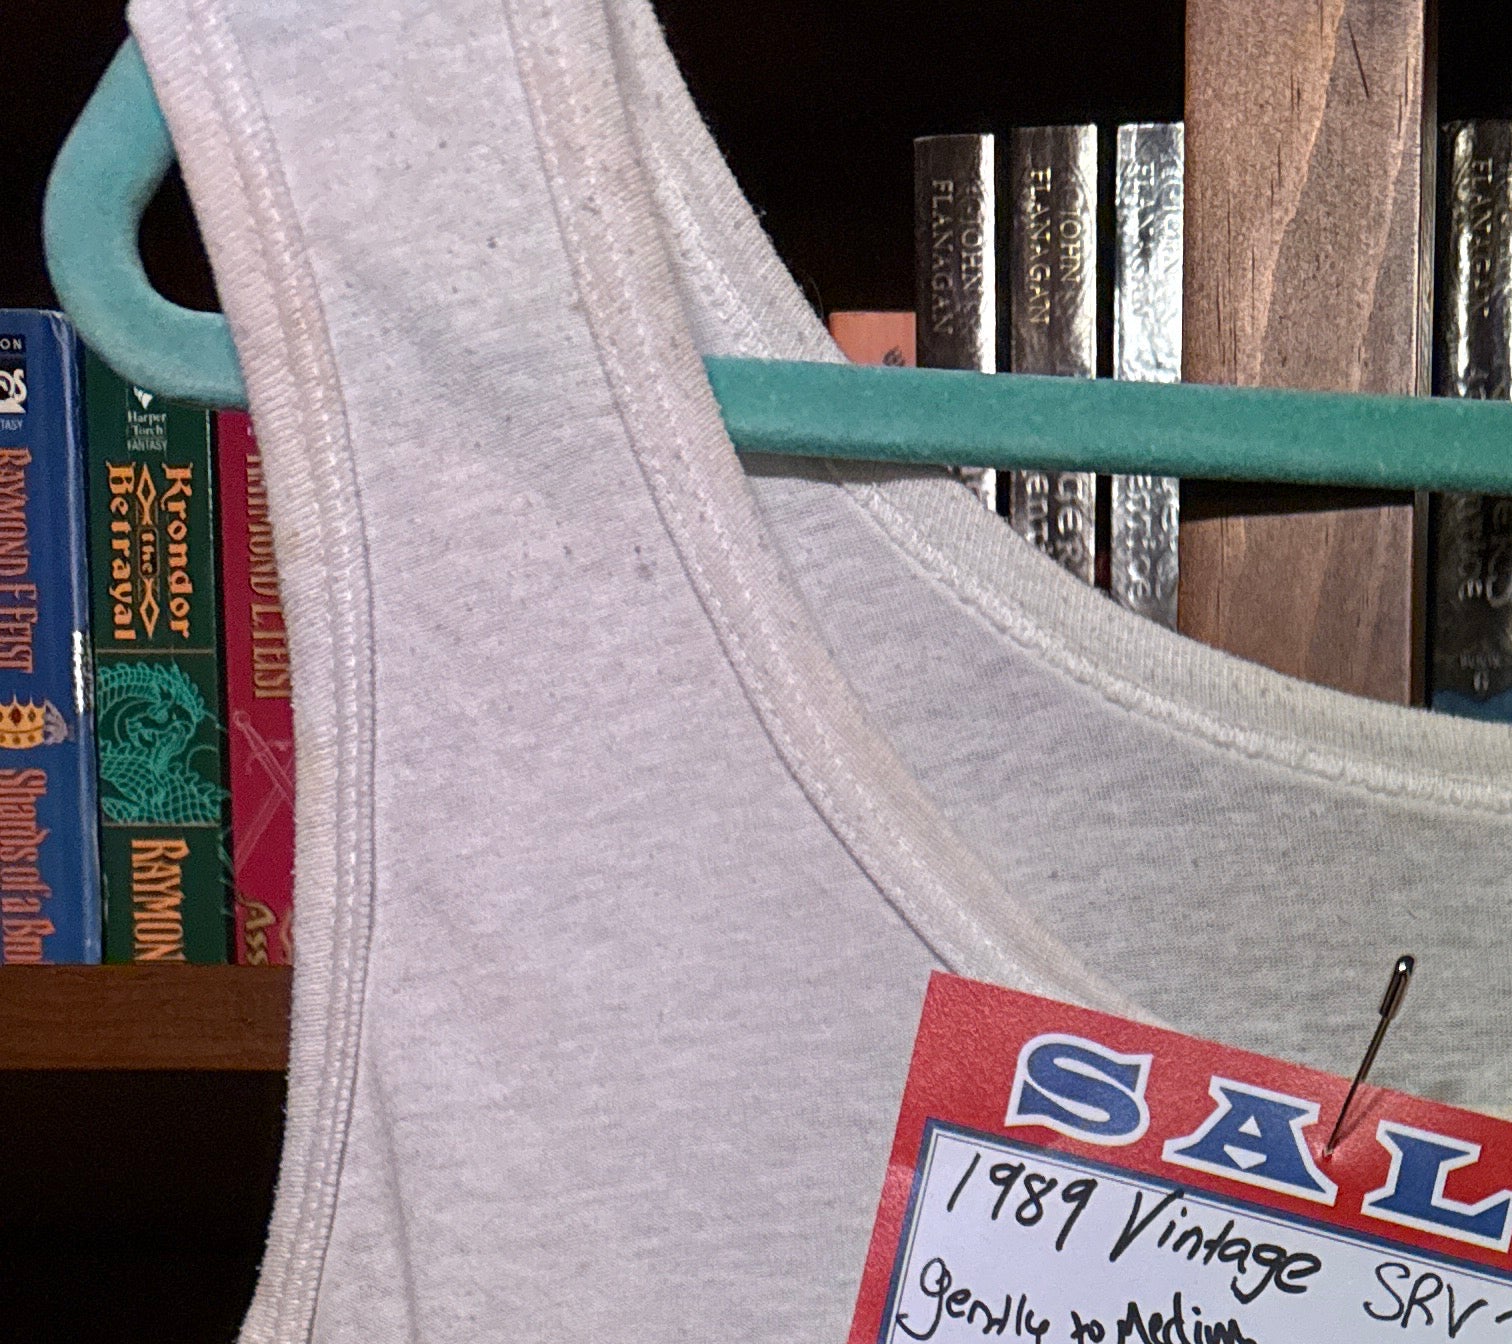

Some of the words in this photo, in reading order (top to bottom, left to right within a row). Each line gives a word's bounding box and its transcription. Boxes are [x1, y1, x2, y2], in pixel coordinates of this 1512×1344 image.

[1029, 167, 1051, 325] FLANAGAN
[127, 438, 167, 451] FANTASY
[128, 411, 167, 424] Harper
[132, 423, 164, 435] Torch
[105, 461, 137, 640] Betrayal
[160, 461, 193, 639] Krondor
[3, 918, 55, 964] Bro
[947, 1152, 1098, 1251] 1989
[1109, 1188, 1322, 1304] Vintage
[1363, 1262, 1488, 1338] SRV
